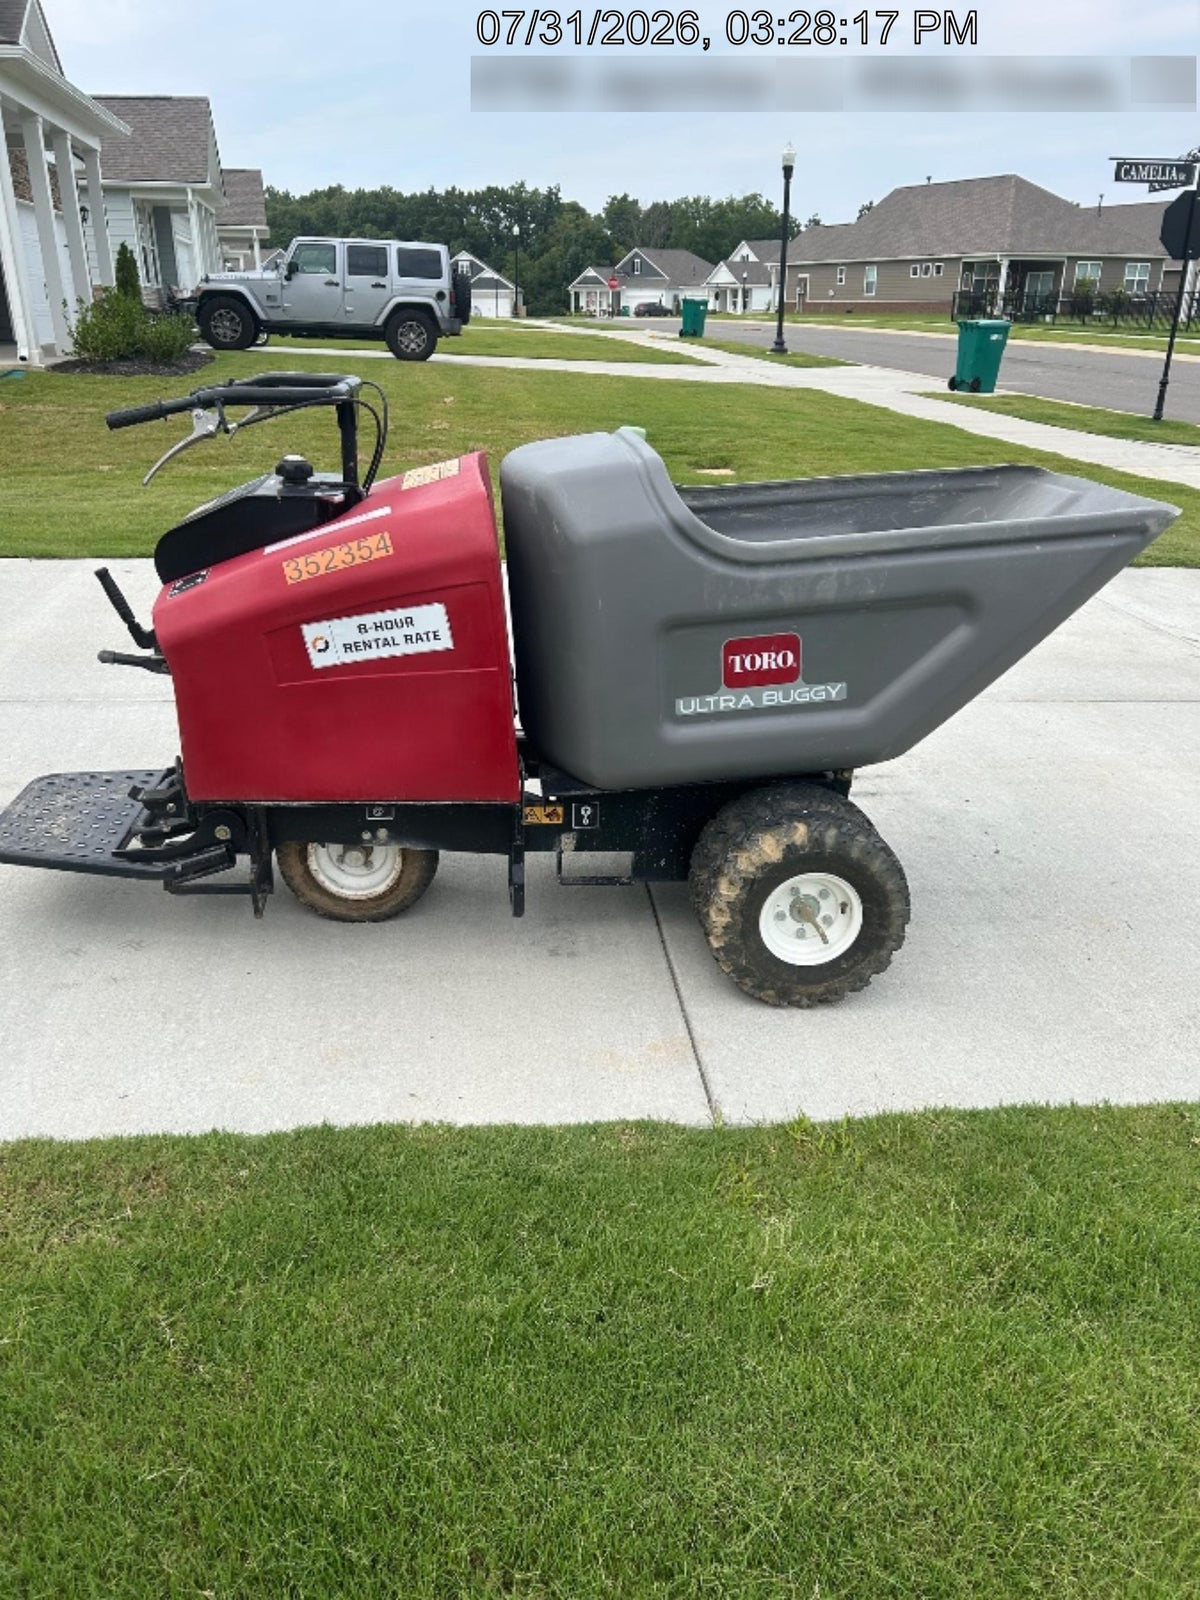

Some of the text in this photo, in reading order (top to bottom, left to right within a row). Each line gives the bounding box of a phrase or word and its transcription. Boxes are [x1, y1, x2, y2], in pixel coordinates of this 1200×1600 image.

[1121, 164, 1177, 181] CAMELIA
[288, 532, 392, 581] 352354
[357, 617, 415, 634] 8-HOUR
[343, 630, 441, 653] RENTAL RATE
[728, 650, 796, 673] TORO
[679, 684, 842, 714] ULTRA BUGGY
